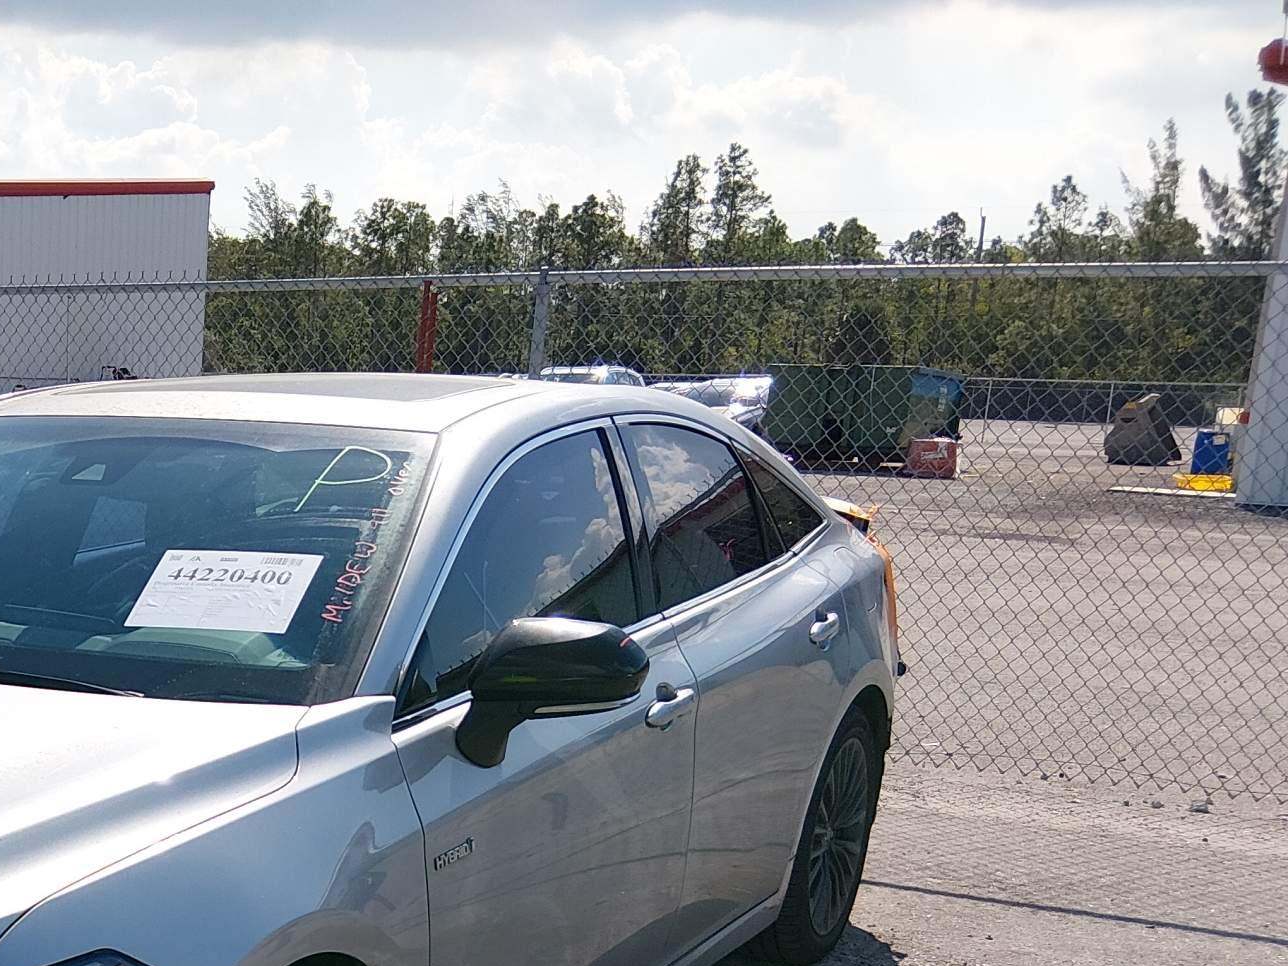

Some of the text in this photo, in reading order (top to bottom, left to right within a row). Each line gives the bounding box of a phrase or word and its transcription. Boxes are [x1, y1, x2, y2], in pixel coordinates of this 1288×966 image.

[293, 446, 392, 512] P
[168, 567, 292, 586] 44220400
[434, 842, 470, 871] HYBRID
